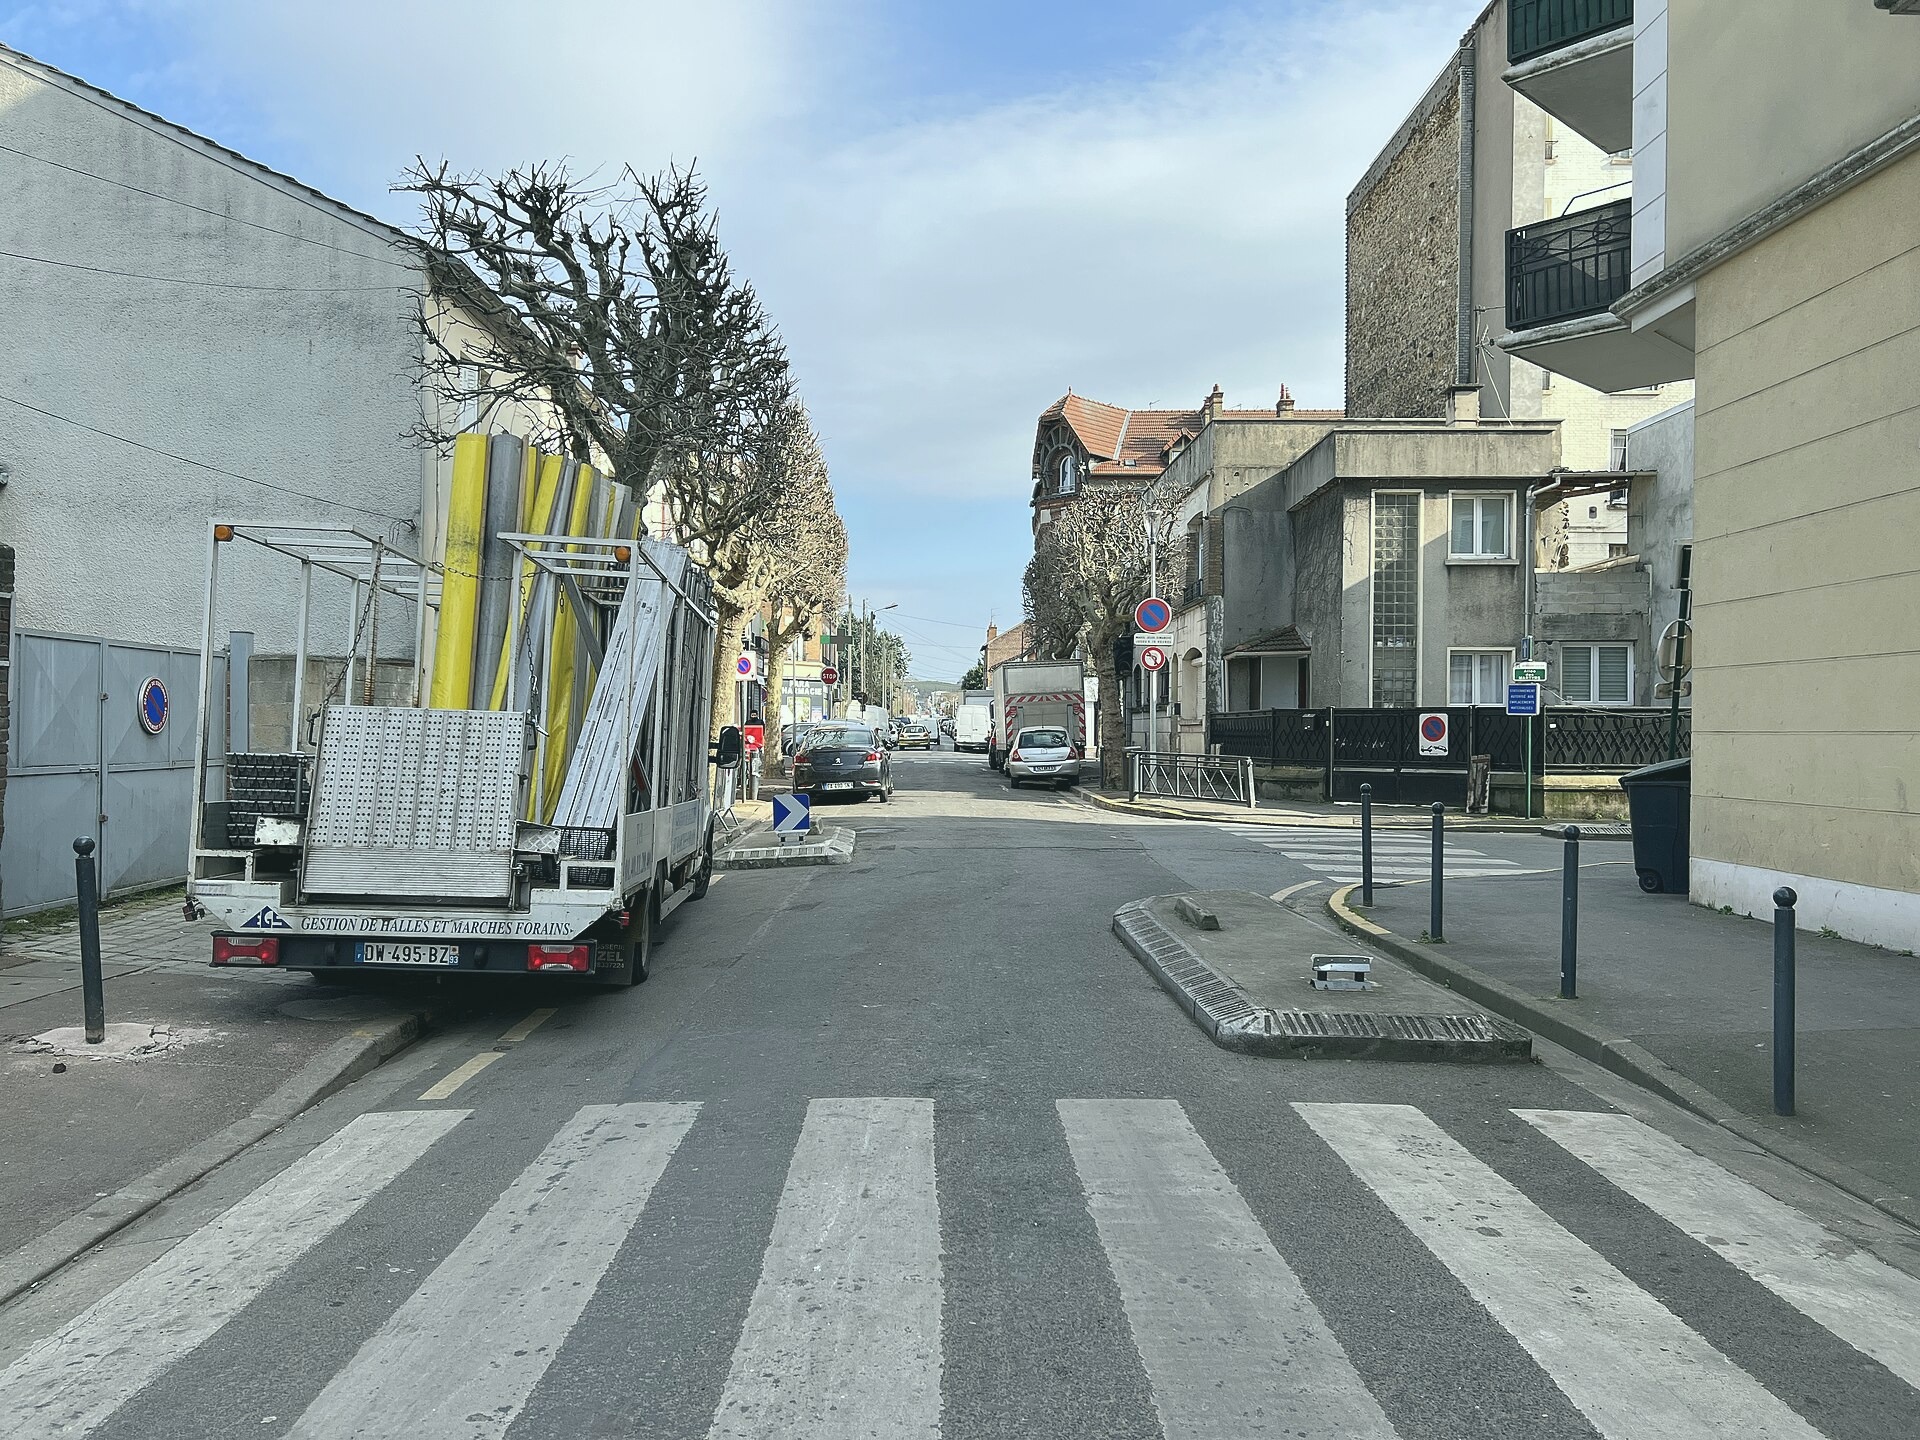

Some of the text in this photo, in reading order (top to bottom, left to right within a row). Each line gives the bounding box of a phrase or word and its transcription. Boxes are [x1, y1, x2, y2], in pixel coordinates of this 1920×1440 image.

[782, 686, 822, 695] HARMACIE
[301, 917, 570, 936] GESTION DE HALLES ET MARCHES FORAINS
[364, 945, 450, 964] DW-495-BZ
[450, 956, 458, 964] 93
